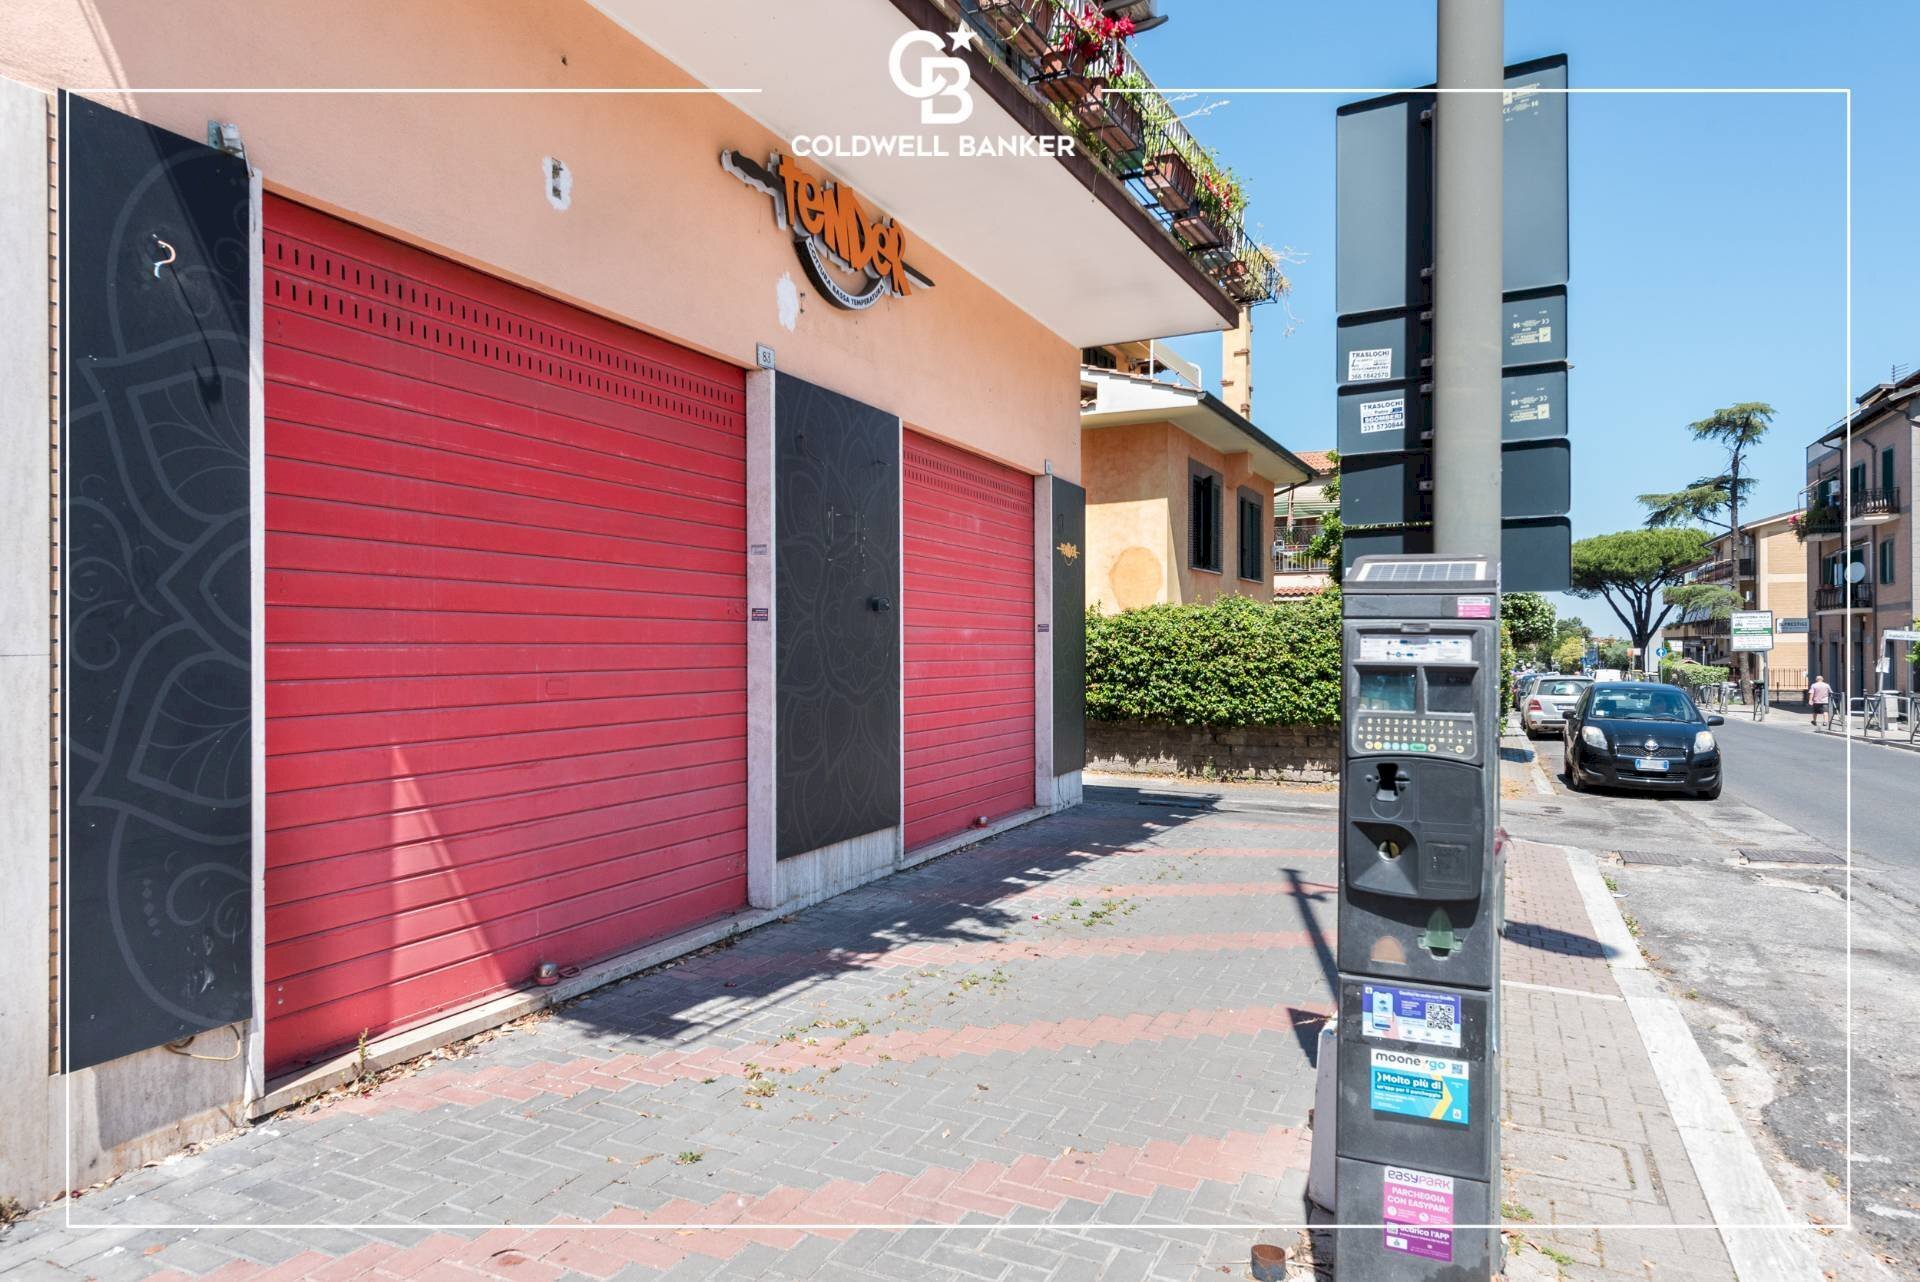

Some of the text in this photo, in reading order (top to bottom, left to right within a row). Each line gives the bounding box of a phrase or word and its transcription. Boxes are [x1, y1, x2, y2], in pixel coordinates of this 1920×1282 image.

[807, 241, 884, 306] COTTURA BASSA TEMPERATURA
[1352, 350, 1390, 358] TRASLOCHI
[1362, 400, 1403, 410] TRASLOCHI
[1383, 1073, 1410, 1085] Molto
[1413, 1079, 1429, 1088] più
[1431, 1081, 1441, 1090] di
[1392, 1186, 1446, 1204] PARCHEGGIA
[1387, 1195, 1407, 1206] CON
[1408, 1199, 1450, 1214] EASYPARK
